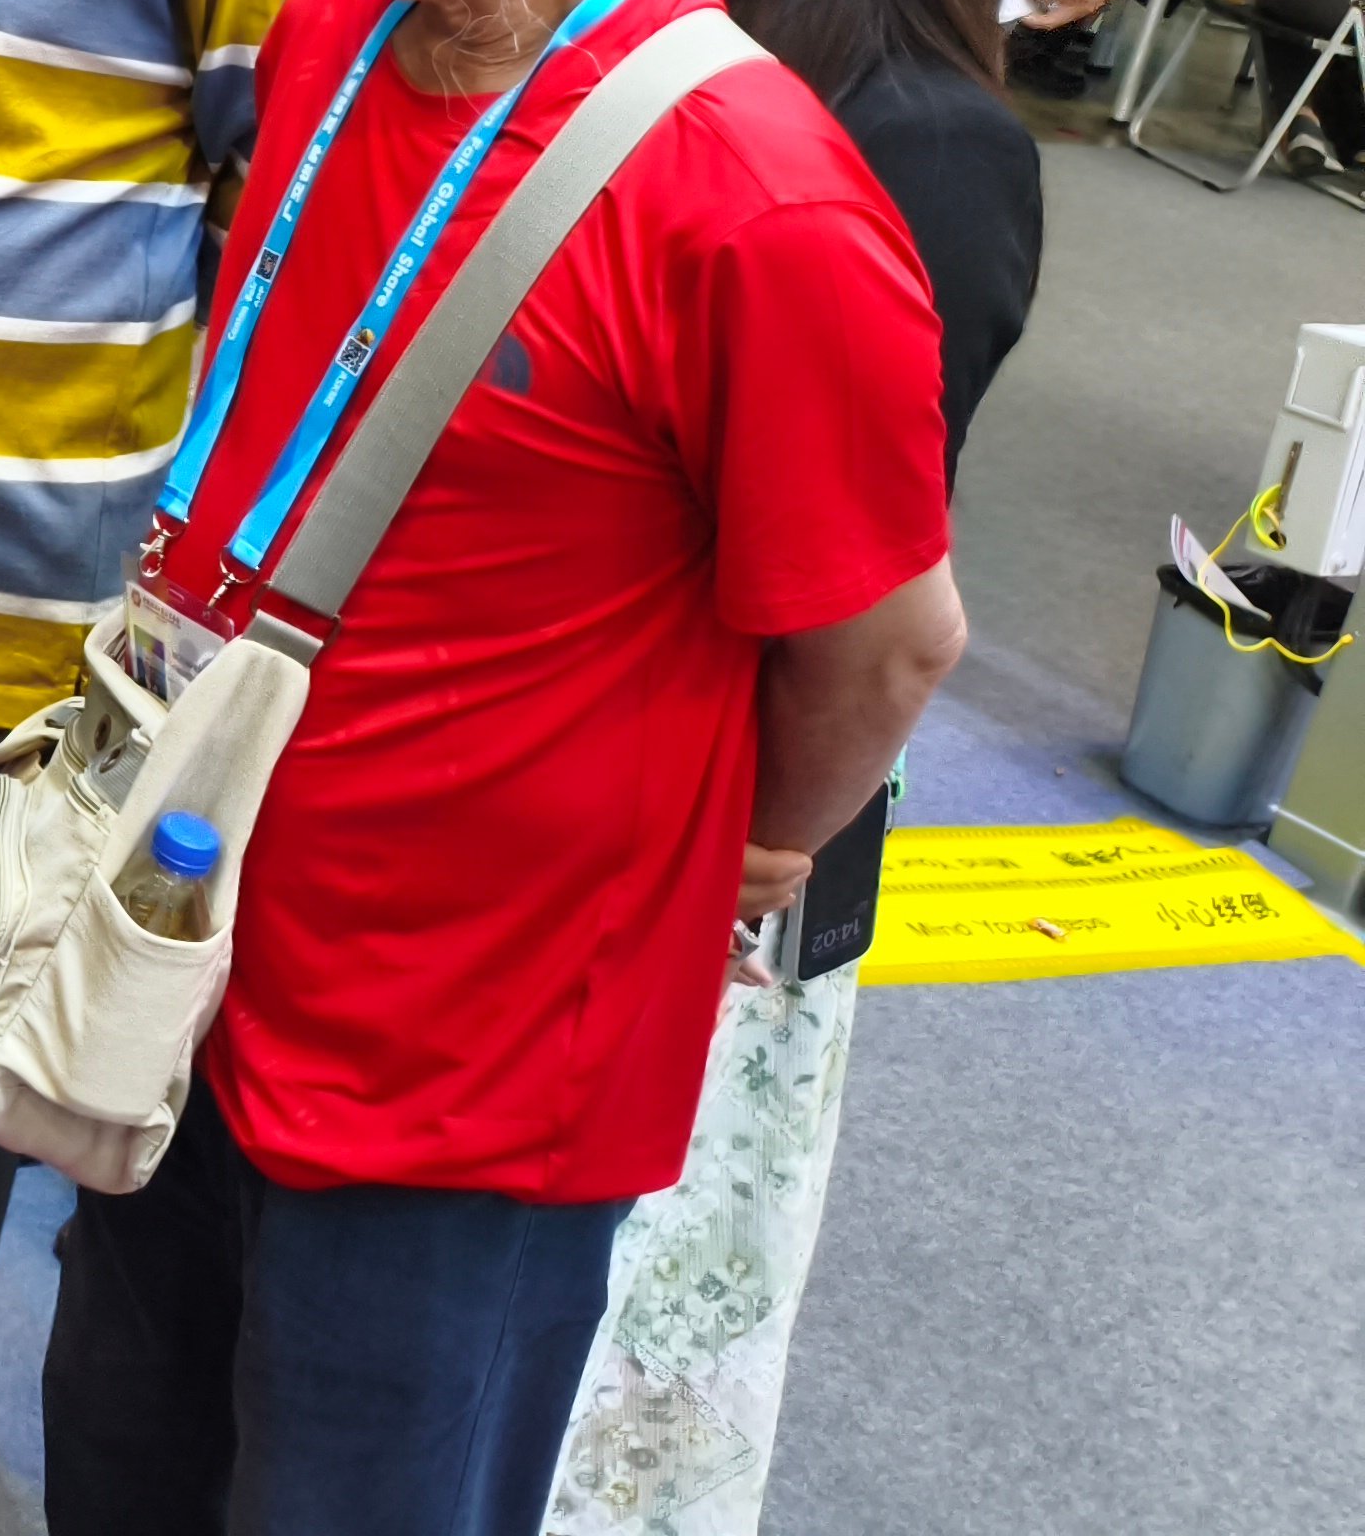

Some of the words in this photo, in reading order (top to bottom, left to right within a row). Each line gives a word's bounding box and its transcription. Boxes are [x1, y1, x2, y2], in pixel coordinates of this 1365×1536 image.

[453, 135, 485, 175] Fair
[410, 182, 455, 248] Global
[375, 252, 414, 308] Share
[811, 917, 861, 954] 14:02
[972, 919, 1037, 935] You
